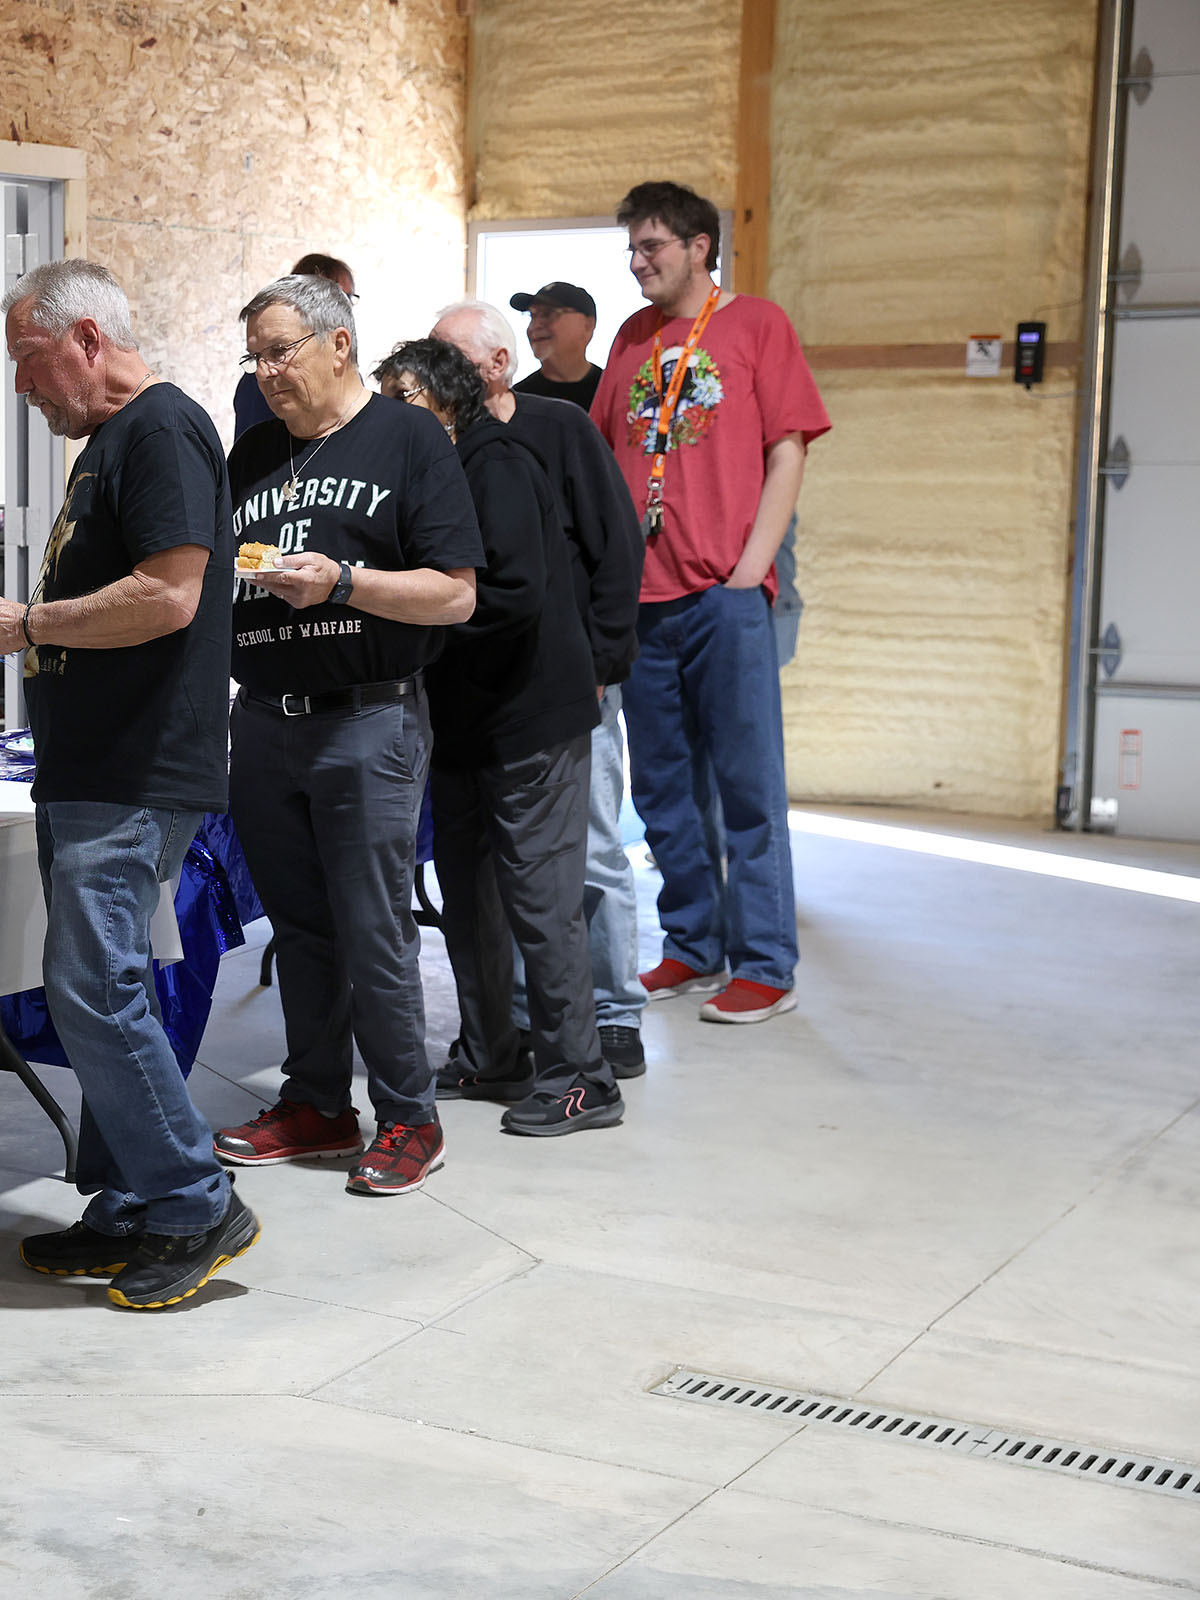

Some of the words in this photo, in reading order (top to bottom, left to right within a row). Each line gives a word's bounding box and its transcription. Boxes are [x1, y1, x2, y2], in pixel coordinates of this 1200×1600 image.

[232, 476, 392, 536] UNIVERSITY
[278, 518, 312, 553] OF
[236, 628, 274, 647] SCHOOL
[279, 626, 293, 640] OF
[298, 620, 361, 638] WARFARE
